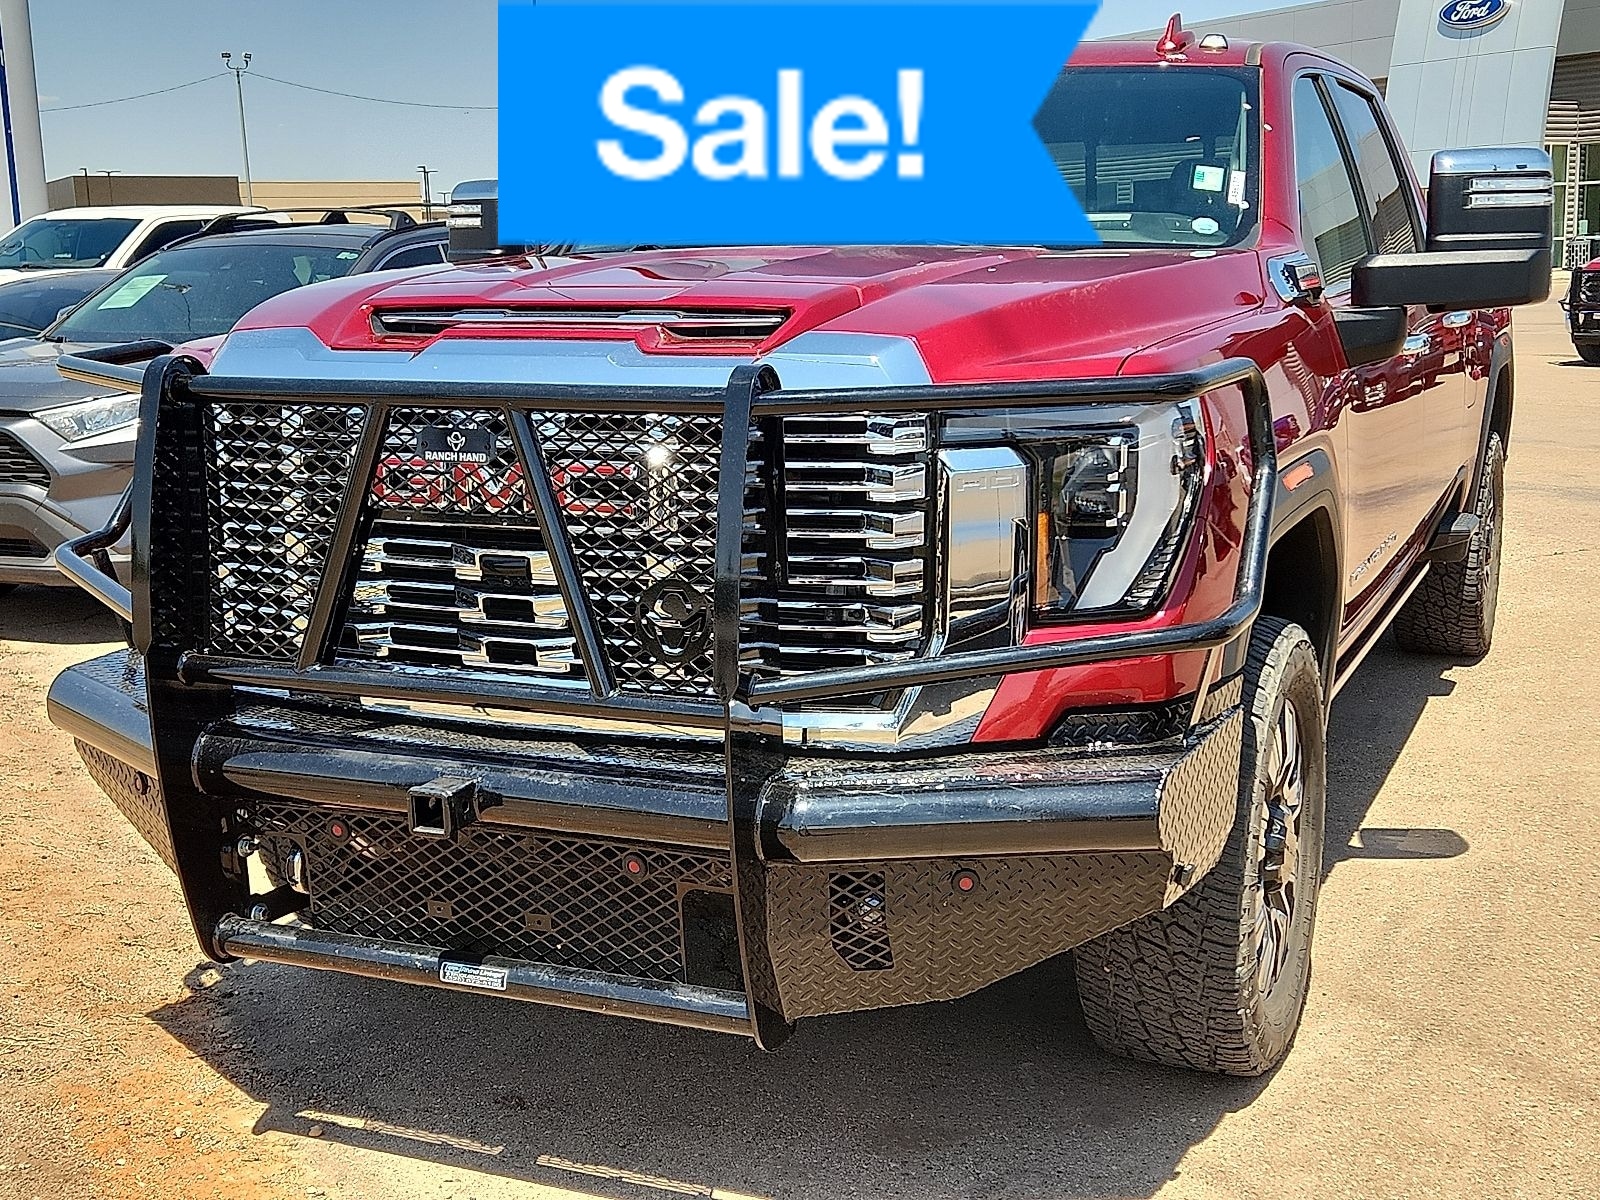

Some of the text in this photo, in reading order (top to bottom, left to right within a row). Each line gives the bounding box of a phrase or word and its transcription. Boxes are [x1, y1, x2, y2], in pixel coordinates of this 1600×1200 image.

[1450, 0, 1491, 21] Ford
[425, 450, 487, 463] RANCH HAND
[369, 455, 638, 517] GMC
